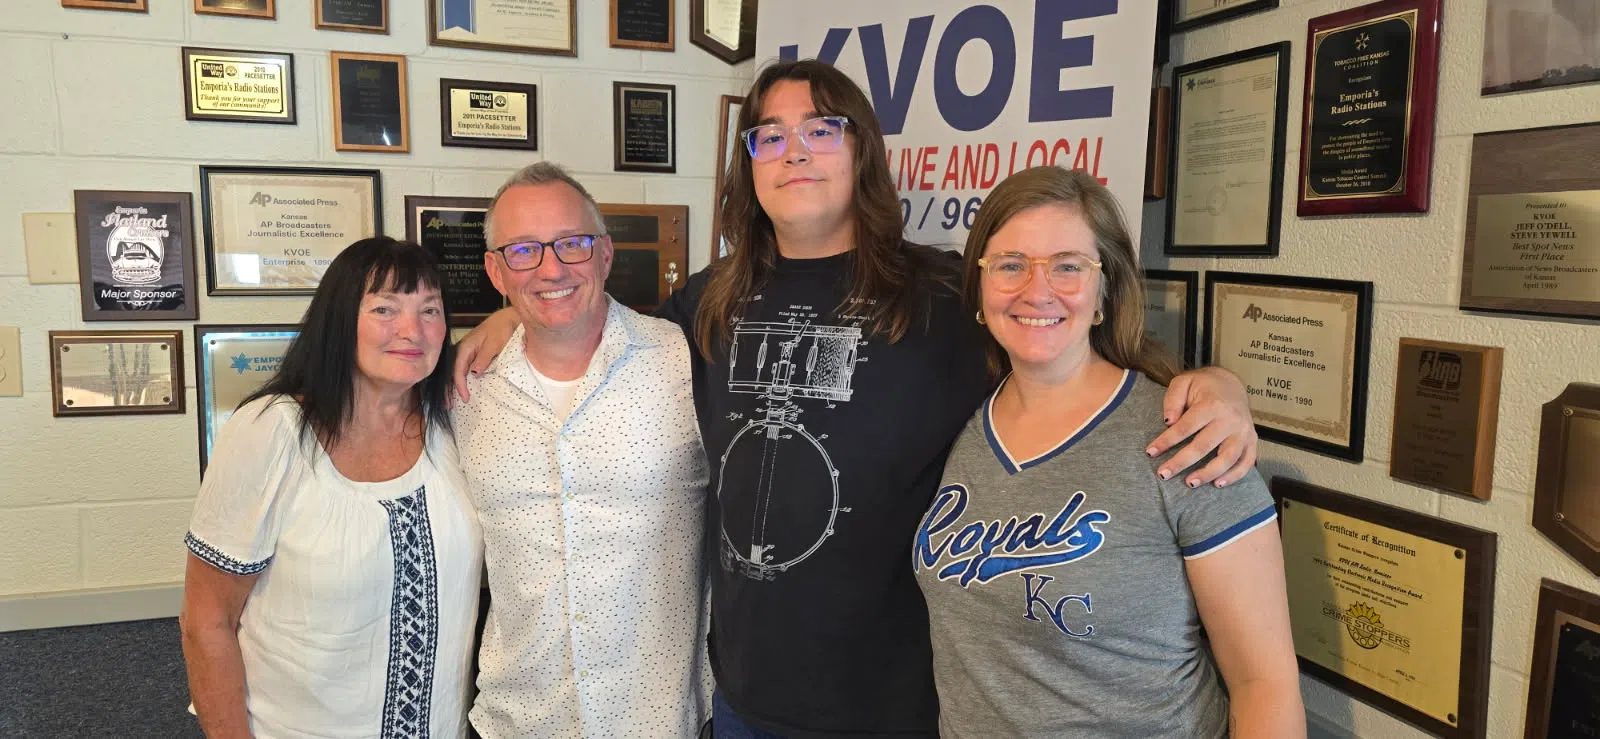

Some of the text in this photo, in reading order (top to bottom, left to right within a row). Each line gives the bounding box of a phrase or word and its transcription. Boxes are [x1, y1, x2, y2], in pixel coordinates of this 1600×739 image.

[1335, 58, 1357, 67] TOBACCO
[1370, 51, 1390, 60] KANSAS
[1344, 60, 1379, 71] COALITION
[210, 70, 223, 78] Way
[200, 81, 279, 94] Emporia's Radio Stations
[471, 93, 492, 101] United
[1340, 89, 1379, 103] Emporia's
[480, 100, 492, 108] Way
[1331, 100, 1387, 115] Radio Stations
[477, 114, 516, 122] PACESETTER
[458, 121, 484, 130] Emporia's
[941, 143, 1000, 190] AND
[249, 192, 272, 207] AP
[273, 198, 316, 206] Associated
[1526, 202, 1558, 210] Presented
[101, 212, 168, 228] Flatland
[941, 197, 982, 230] 96
[1515, 222, 1572, 232] JEFF O'DELL,
[1511, 231, 1576, 240] STEVE YEWELL
[1531, 243, 1550, 251] Spot
[1520, 253, 1565, 261] First Place
[1489, 264, 1524, 272] Association
[101, 289, 176, 300] Major Sponsor
[1243, 304, 1324, 328] AP Associated Press
[1269, 333, 1293, 343] Kansas
[1251, 340, 1314, 357] AP Broadcasters
[1239, 349, 1326, 371] Journalistic Excellence
[1267, 377, 1292, 390] KVOE
[1247, 385, 1263, 396] Spot
[1266, 389, 1288, 401] News
[1295, 396, 1313, 407] 1990
[912, 483, 1111, 588] Royals
[1324, 522, 1416, 557] Certificate of Recognition
[1019, 573, 1094, 637] KC
[1322, 607, 1353, 625] CRIME
[1355, 620, 1411, 648] STOPPERS
